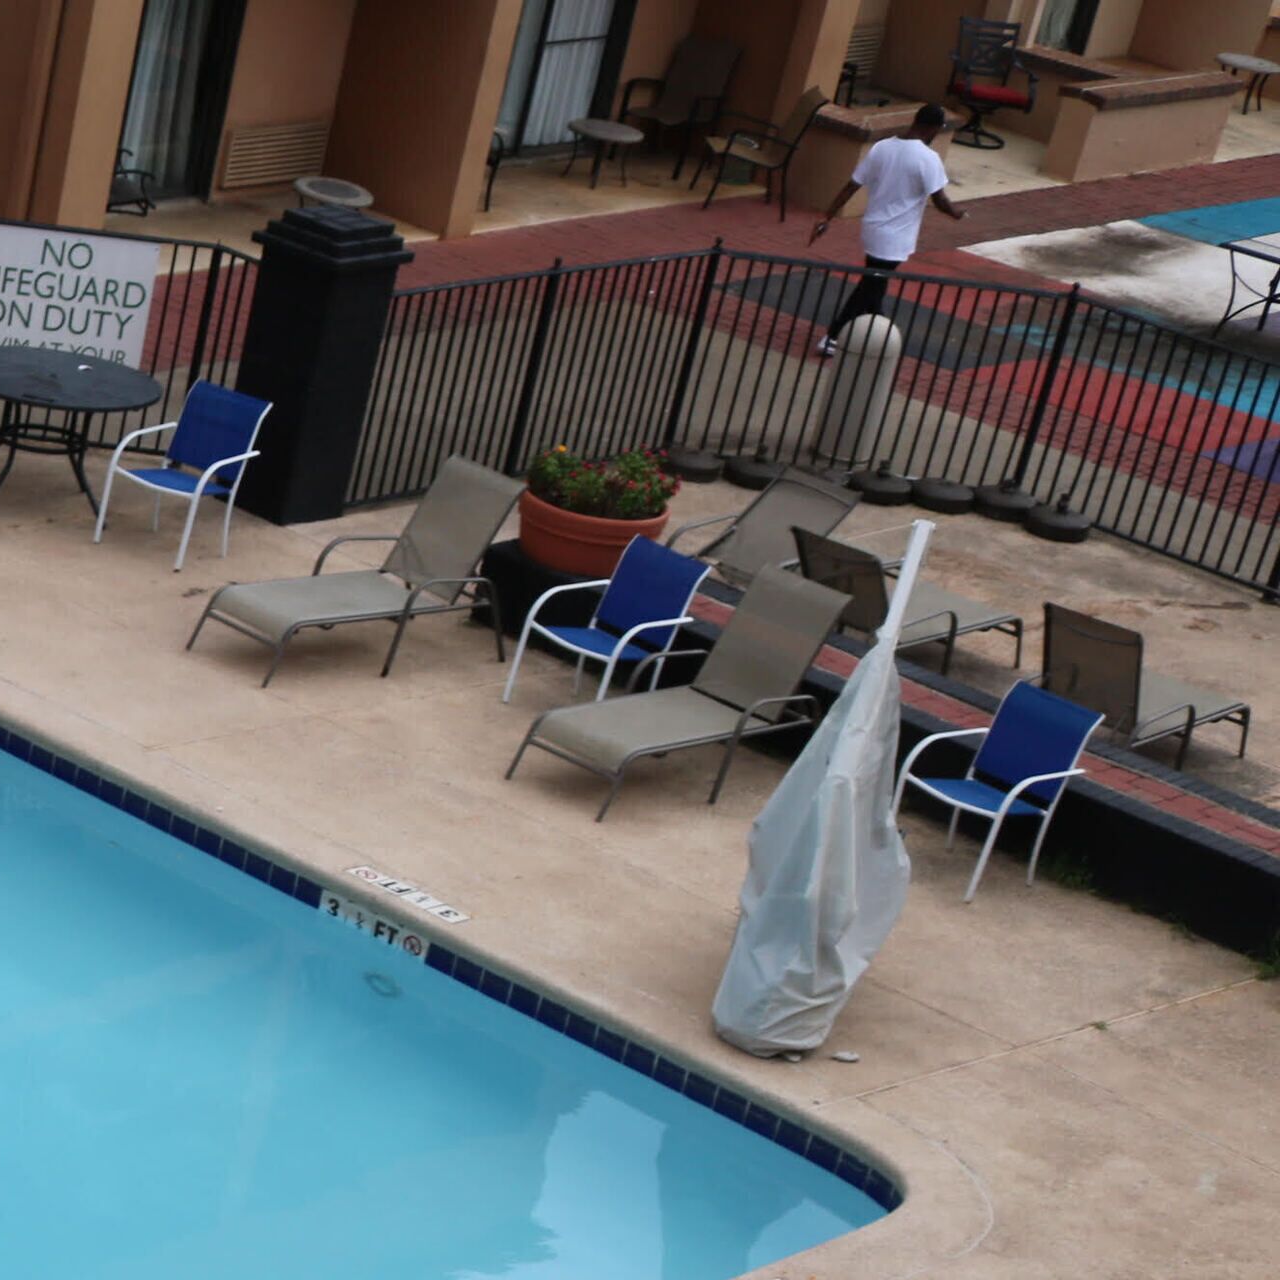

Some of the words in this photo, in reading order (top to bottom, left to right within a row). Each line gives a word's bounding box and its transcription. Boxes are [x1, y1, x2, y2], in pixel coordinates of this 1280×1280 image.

[41, 239, 93, 269] NO
[43, 304, 134, 340] DUTY
[326, 898, 340, 917] 3
[374, 919, 399, 945] FT
